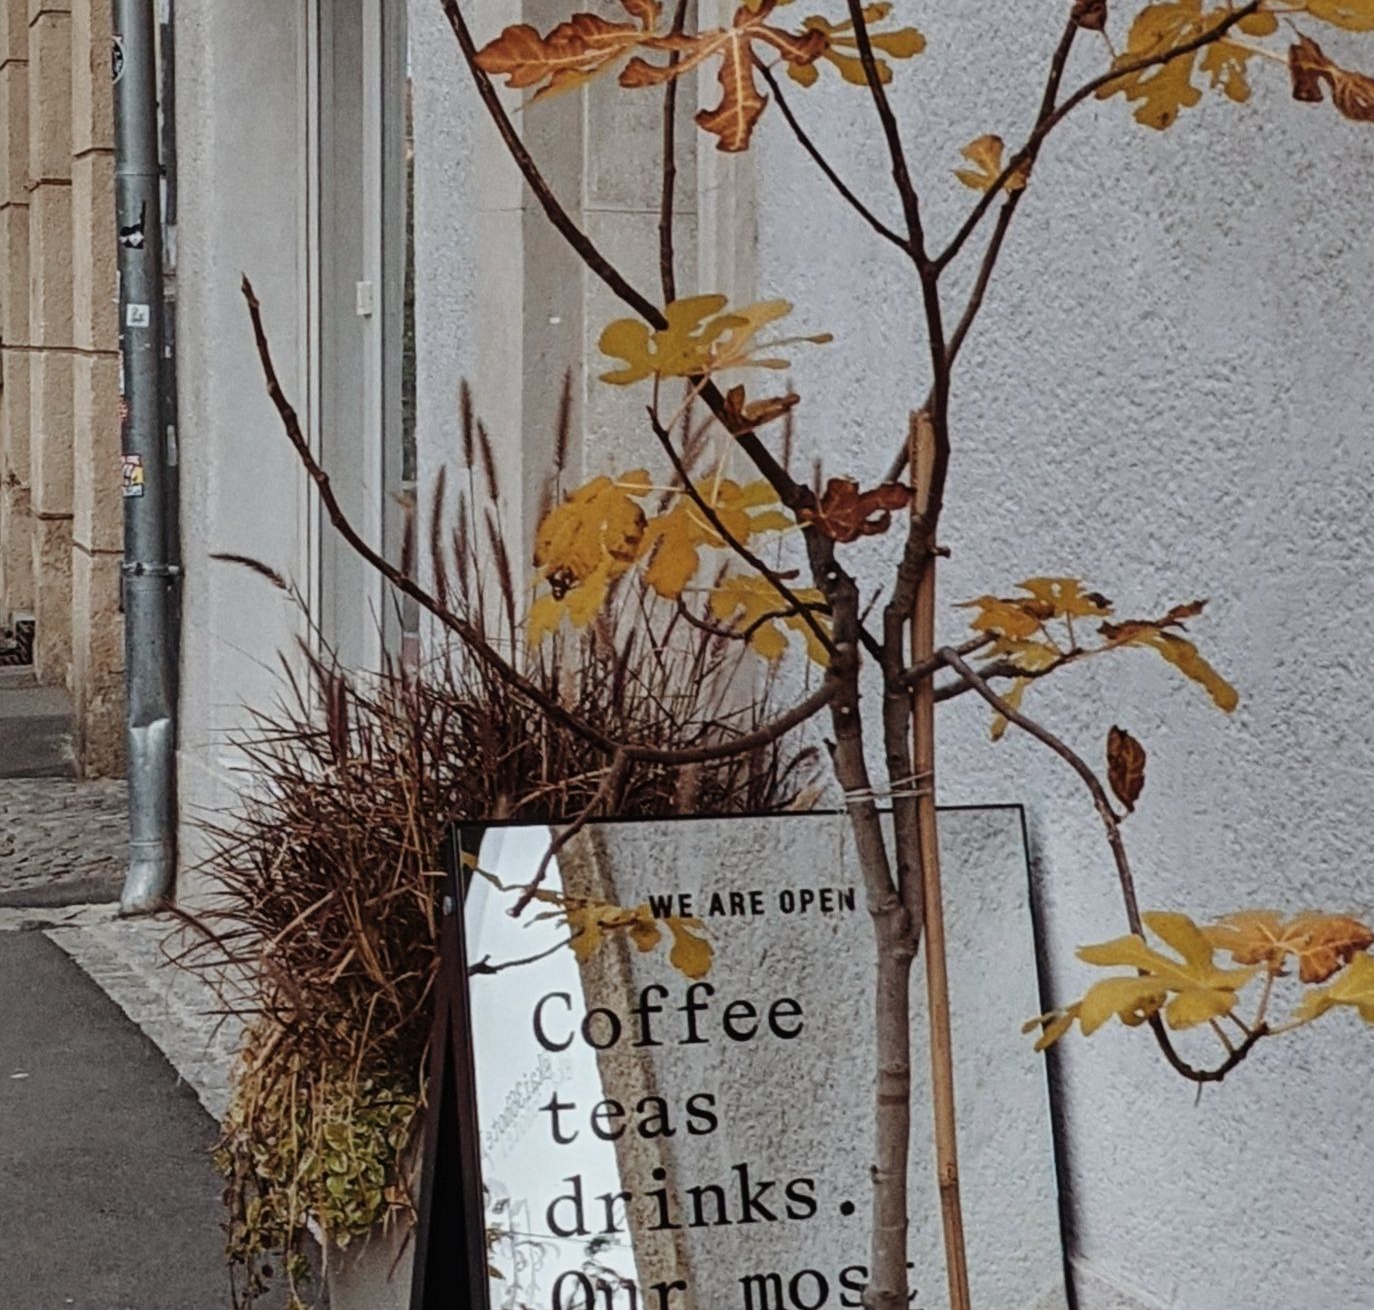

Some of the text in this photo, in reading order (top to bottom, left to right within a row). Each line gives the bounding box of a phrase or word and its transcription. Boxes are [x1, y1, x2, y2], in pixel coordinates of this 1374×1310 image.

[649, 887, 857, 920] WE ARE OPEN
[532, 982, 804, 1053] Coffee
[538, 1091, 719, 1145] teas
[546, 1163, 856, 1238] drinks.
